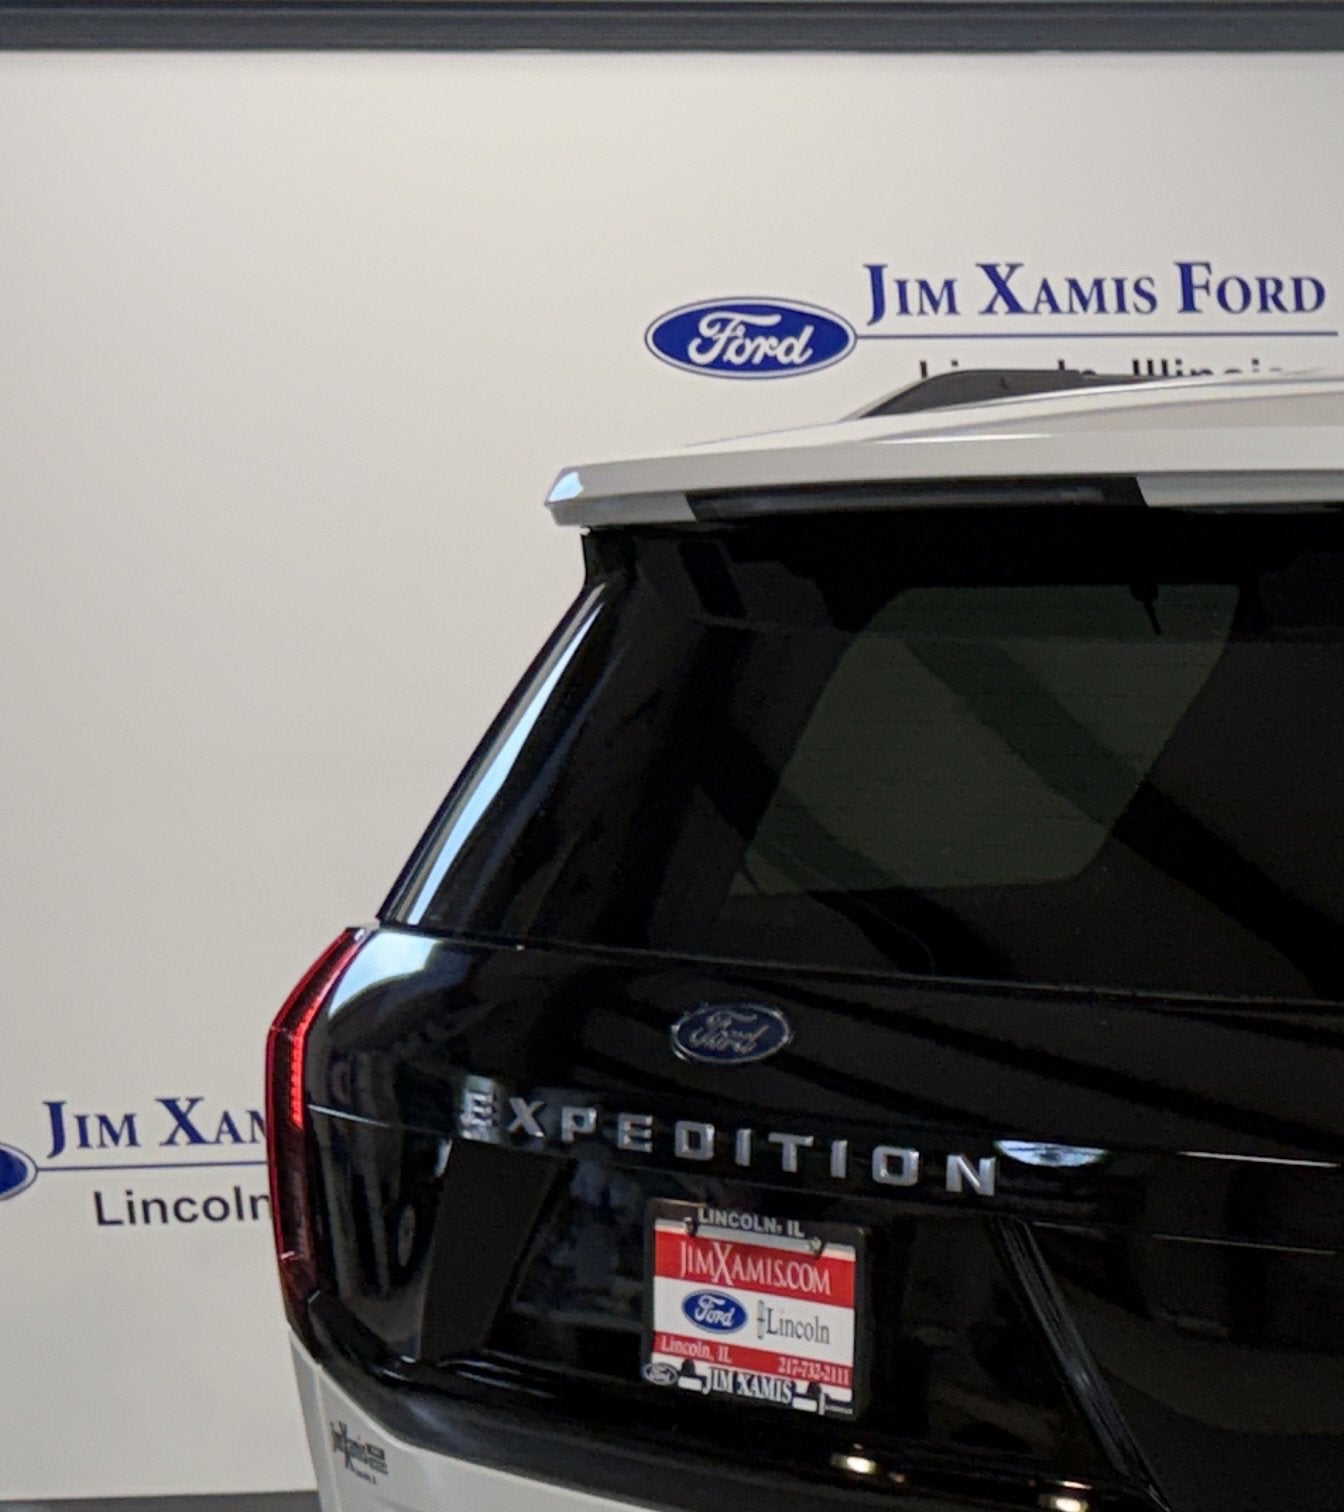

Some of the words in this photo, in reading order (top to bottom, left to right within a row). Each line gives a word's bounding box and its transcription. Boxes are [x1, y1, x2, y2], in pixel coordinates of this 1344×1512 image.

[863, 263, 961, 326] JIM
[975, 262, 1159, 316] XAMIS
[1173, 261, 1327, 315] FORD
[687, 311, 815, 366] Ford
[688, 1009, 771, 1054] Ford
[43, 1100, 142, 1159] JIM
[463, 1090, 997, 1196] EXPEDITION
[786, 1219, 806, 1238] IL
[694, 1294, 736, 1328] Ford
[766, 1307, 831, 1344] Lincoln
[702, 1366, 734, 1395] JIM
[737, 1371, 793, 1404] XAMIS
